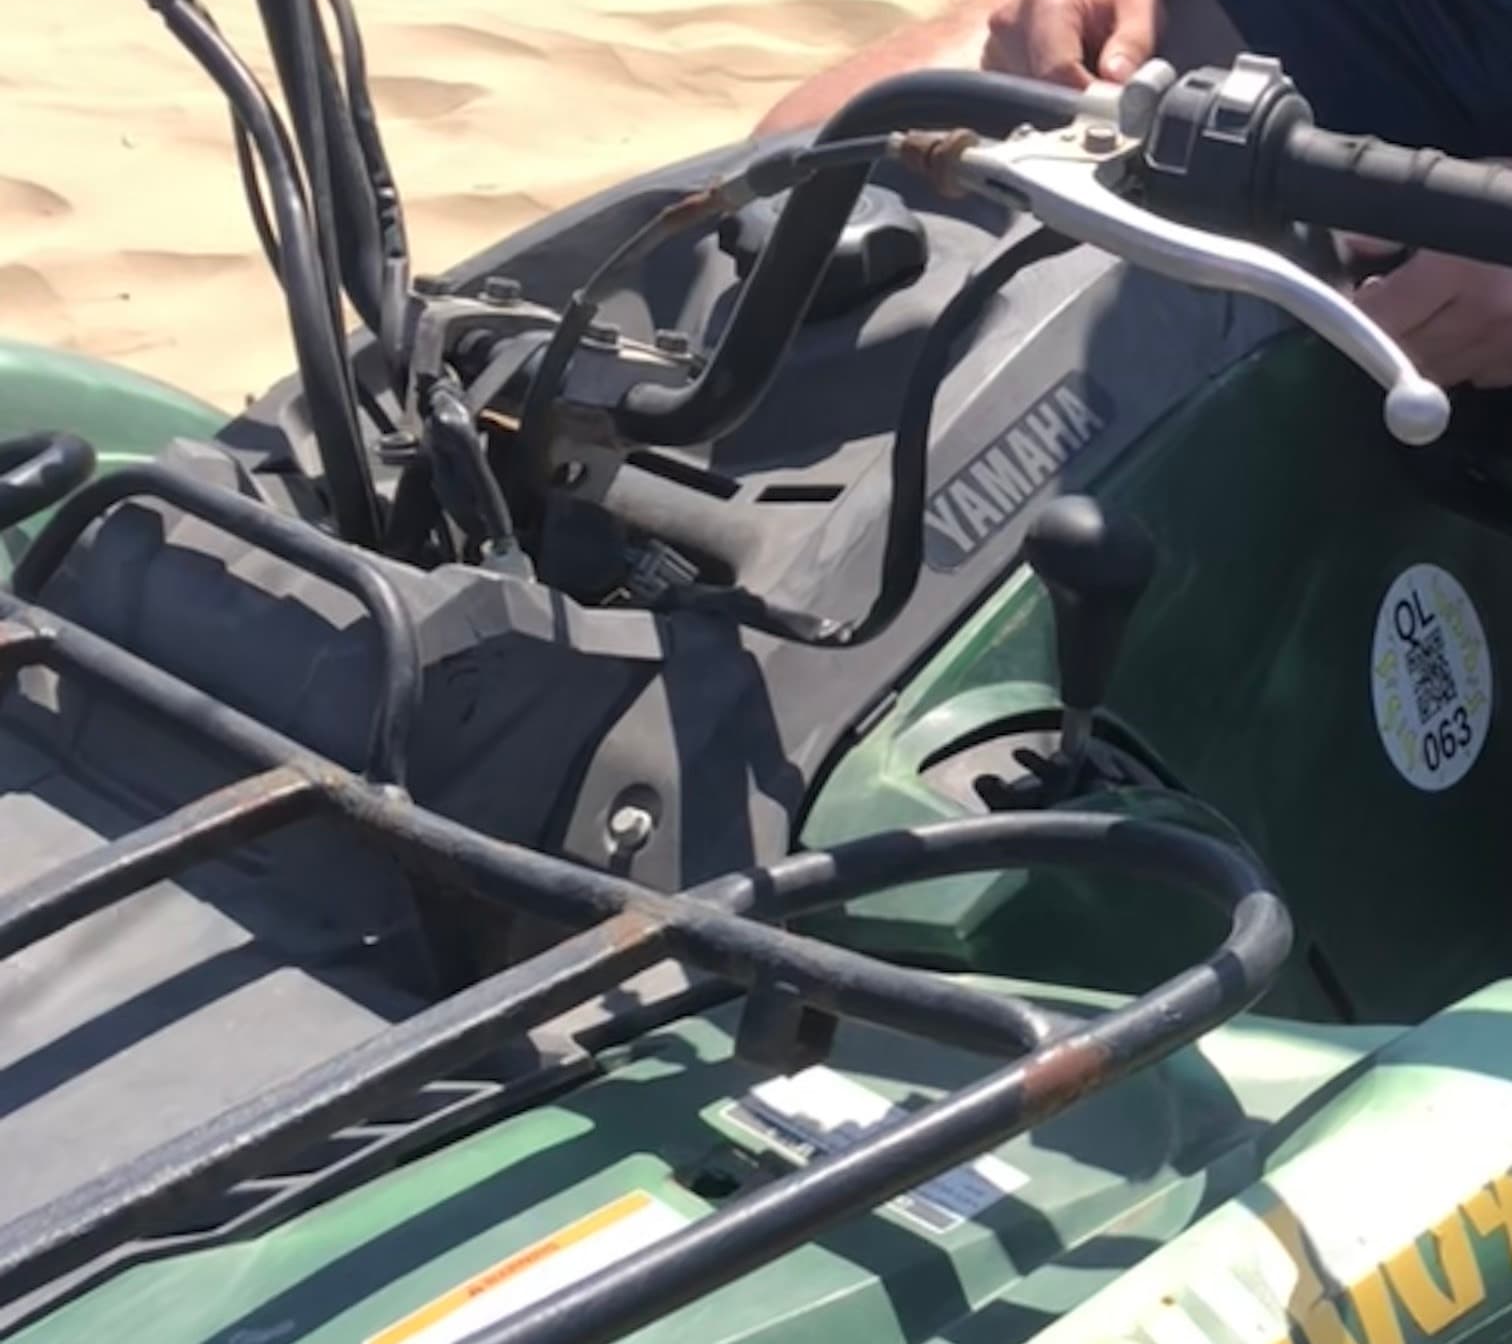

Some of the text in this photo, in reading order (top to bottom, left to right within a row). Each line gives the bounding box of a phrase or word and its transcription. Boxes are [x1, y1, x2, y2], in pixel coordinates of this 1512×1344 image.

[924, 386, 1105, 553] YAMAHA
[1394, 589, 1437, 647] QL
[1422, 706, 1473, 773] 063
